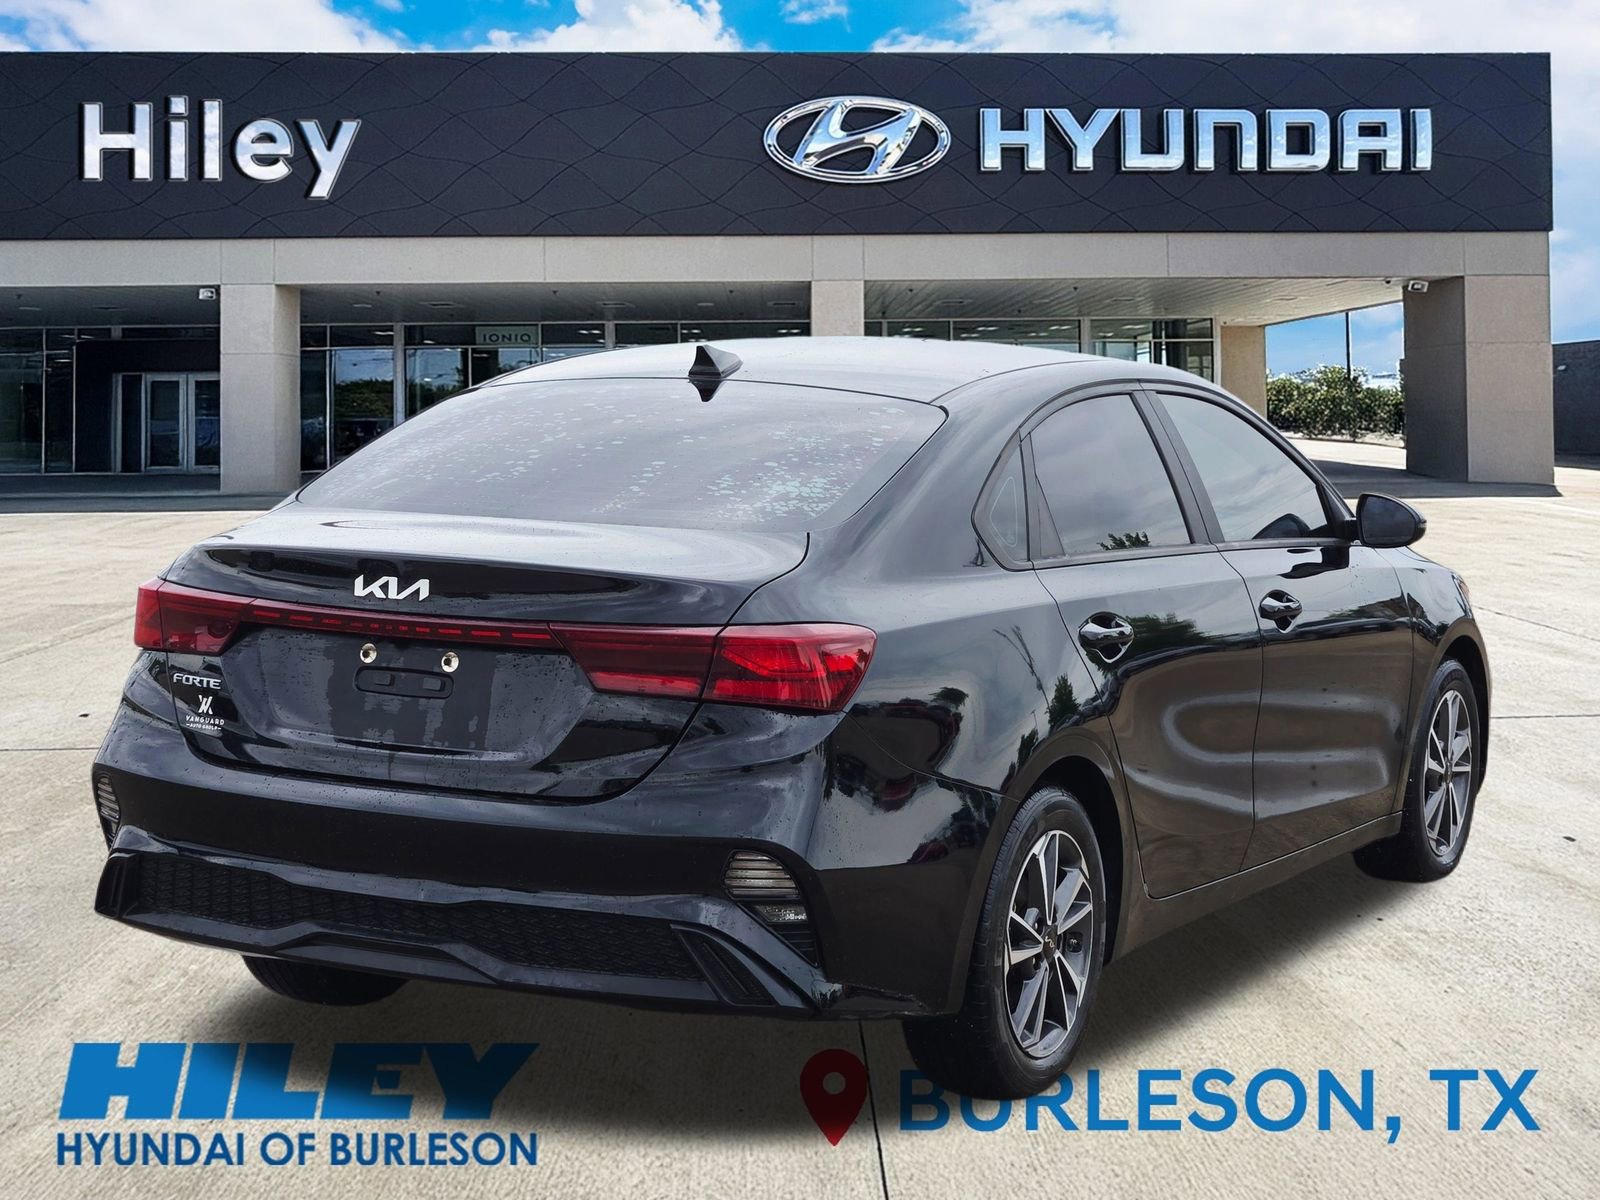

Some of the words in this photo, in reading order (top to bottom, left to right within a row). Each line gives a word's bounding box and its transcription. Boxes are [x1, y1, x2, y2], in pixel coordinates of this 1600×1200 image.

[80, 95, 361, 200] Hiley
[979, 107, 1433, 172] HYUNDAI
[483, 333, 532, 343] IONIQ
[353, 574, 430, 602] KIA
[172, 672, 222, 690] FORTE
[185, 715, 225, 725] VANGUARD
